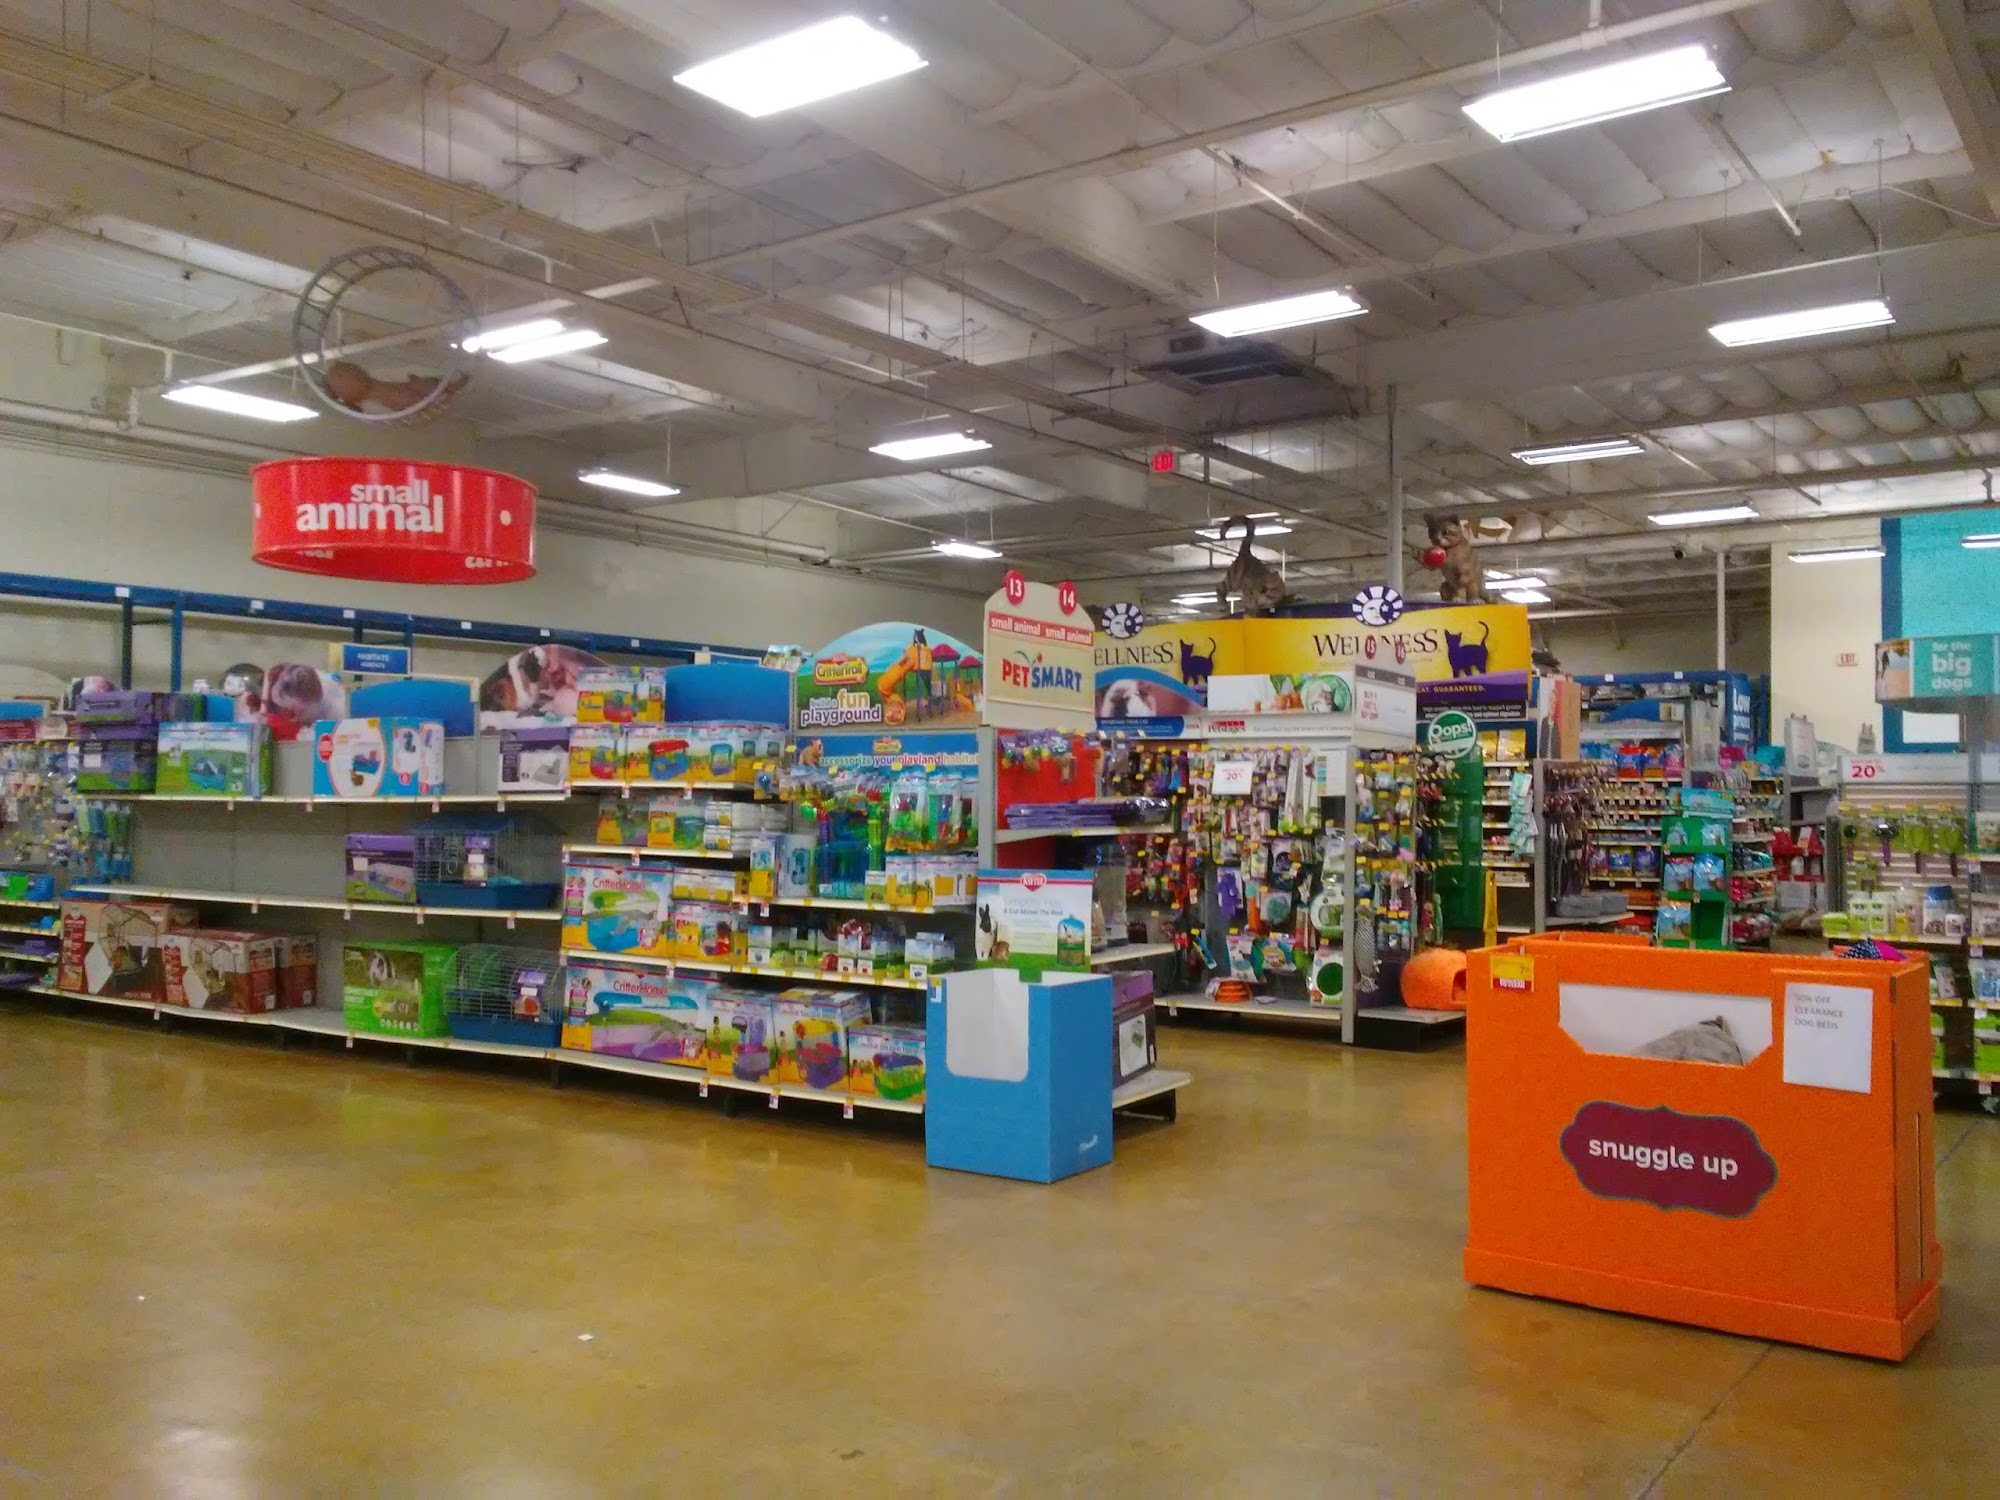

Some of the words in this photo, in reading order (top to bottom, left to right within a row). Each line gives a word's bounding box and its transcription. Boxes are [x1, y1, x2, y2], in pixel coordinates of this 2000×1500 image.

[350, 479, 429, 506] small
[296, 495, 444, 534] animal
[1009, 578, 1022, 596] 13
[1062, 589, 1074, 608] 14
[991, 616, 1013, 632] small
[1014, 620, 1041, 636] animal
[1045, 628, 1066, 642] small
[1067, 631, 1092, 645] animal
[1094, 641, 1175, 666] ELLNESS
[1366, 638, 1376, 654] 15
[1932, 642, 1949, 651] for
[1951, 641, 1972, 650] the
[1931, 652, 1972, 676] big
[1433, 685, 1486, 694] GUARANTEED.
[1930, 676, 1974, 692] dogs
[838, 690, 870, 709] fun
[1732, 687, 1750, 714] Low
[802, 705, 881, 725] playground
[1429, 719, 1473, 744] Oops!
[821, 754, 873, 765] accessorize
[874, 755, 898, 767] your
[898, 752, 940, 764] playland
[592, 877, 646, 891] CritterHome
[613, 980, 668, 997] CritterHome
[1816, 995, 1831, 1004] OFF
[1794, 1005, 1845, 1018] CLEARANCE
[1794, 1018, 1814, 1028] DOG
[1816, 1020, 1839, 1030] BEDS
[1588, 1138, 1695, 1171] snuggle
[1703, 1154, 1739, 1181] up
